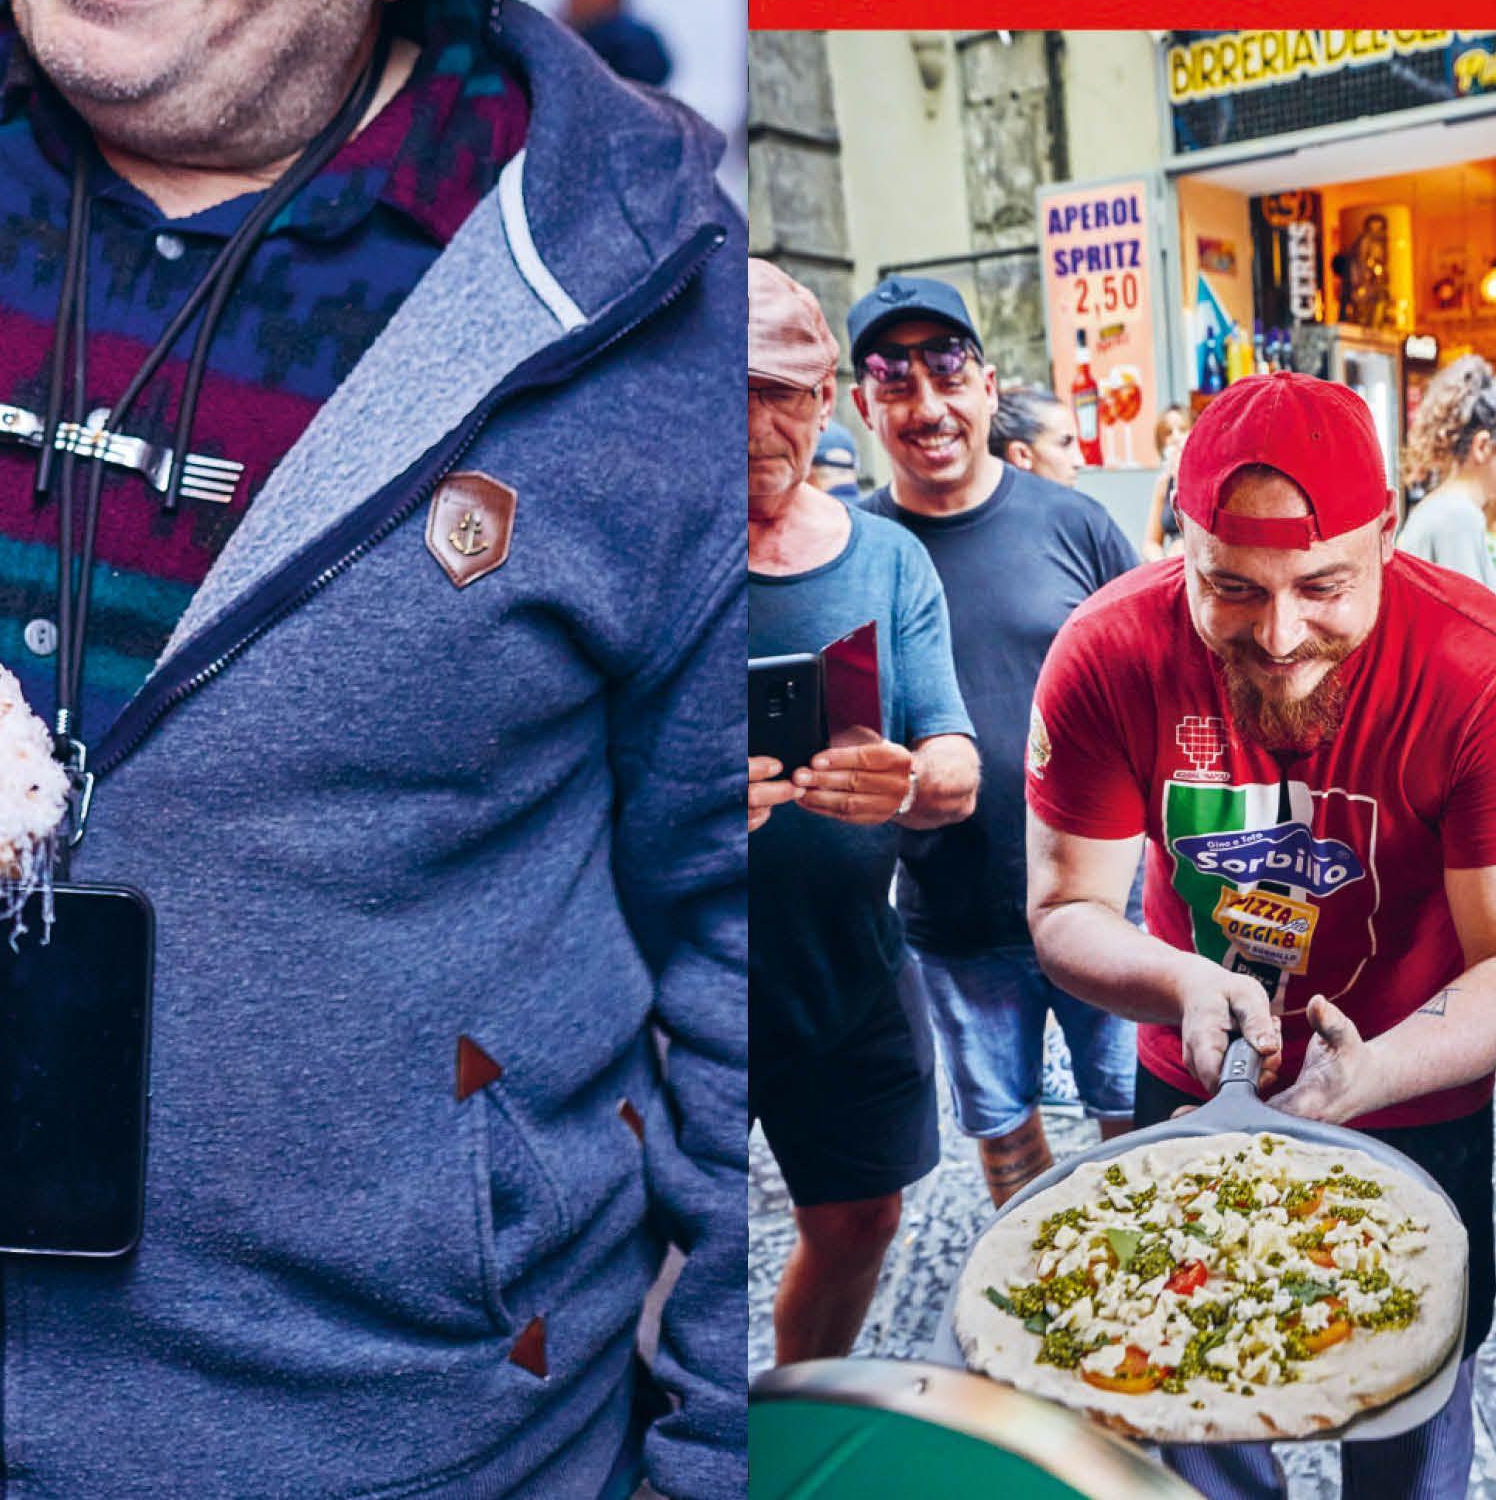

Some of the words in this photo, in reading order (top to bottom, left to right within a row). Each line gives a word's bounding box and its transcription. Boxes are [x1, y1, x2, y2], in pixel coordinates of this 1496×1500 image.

[1171, 30, 1318, 97] BIRRERIA
[1048, 195, 1140, 236] APEROL
[1053, 239, 1141, 277] SPRITZ
[1074, 271, 1138, 320] 2,50
[1207, 839, 1231, 850] Gino
[1196, 848, 1348, 887] Sorbillo
[1226, 896, 1293, 925] PIZZA
[1227, 920, 1273, 943] OGGI
[1283, 931, 1296, 949] 8
